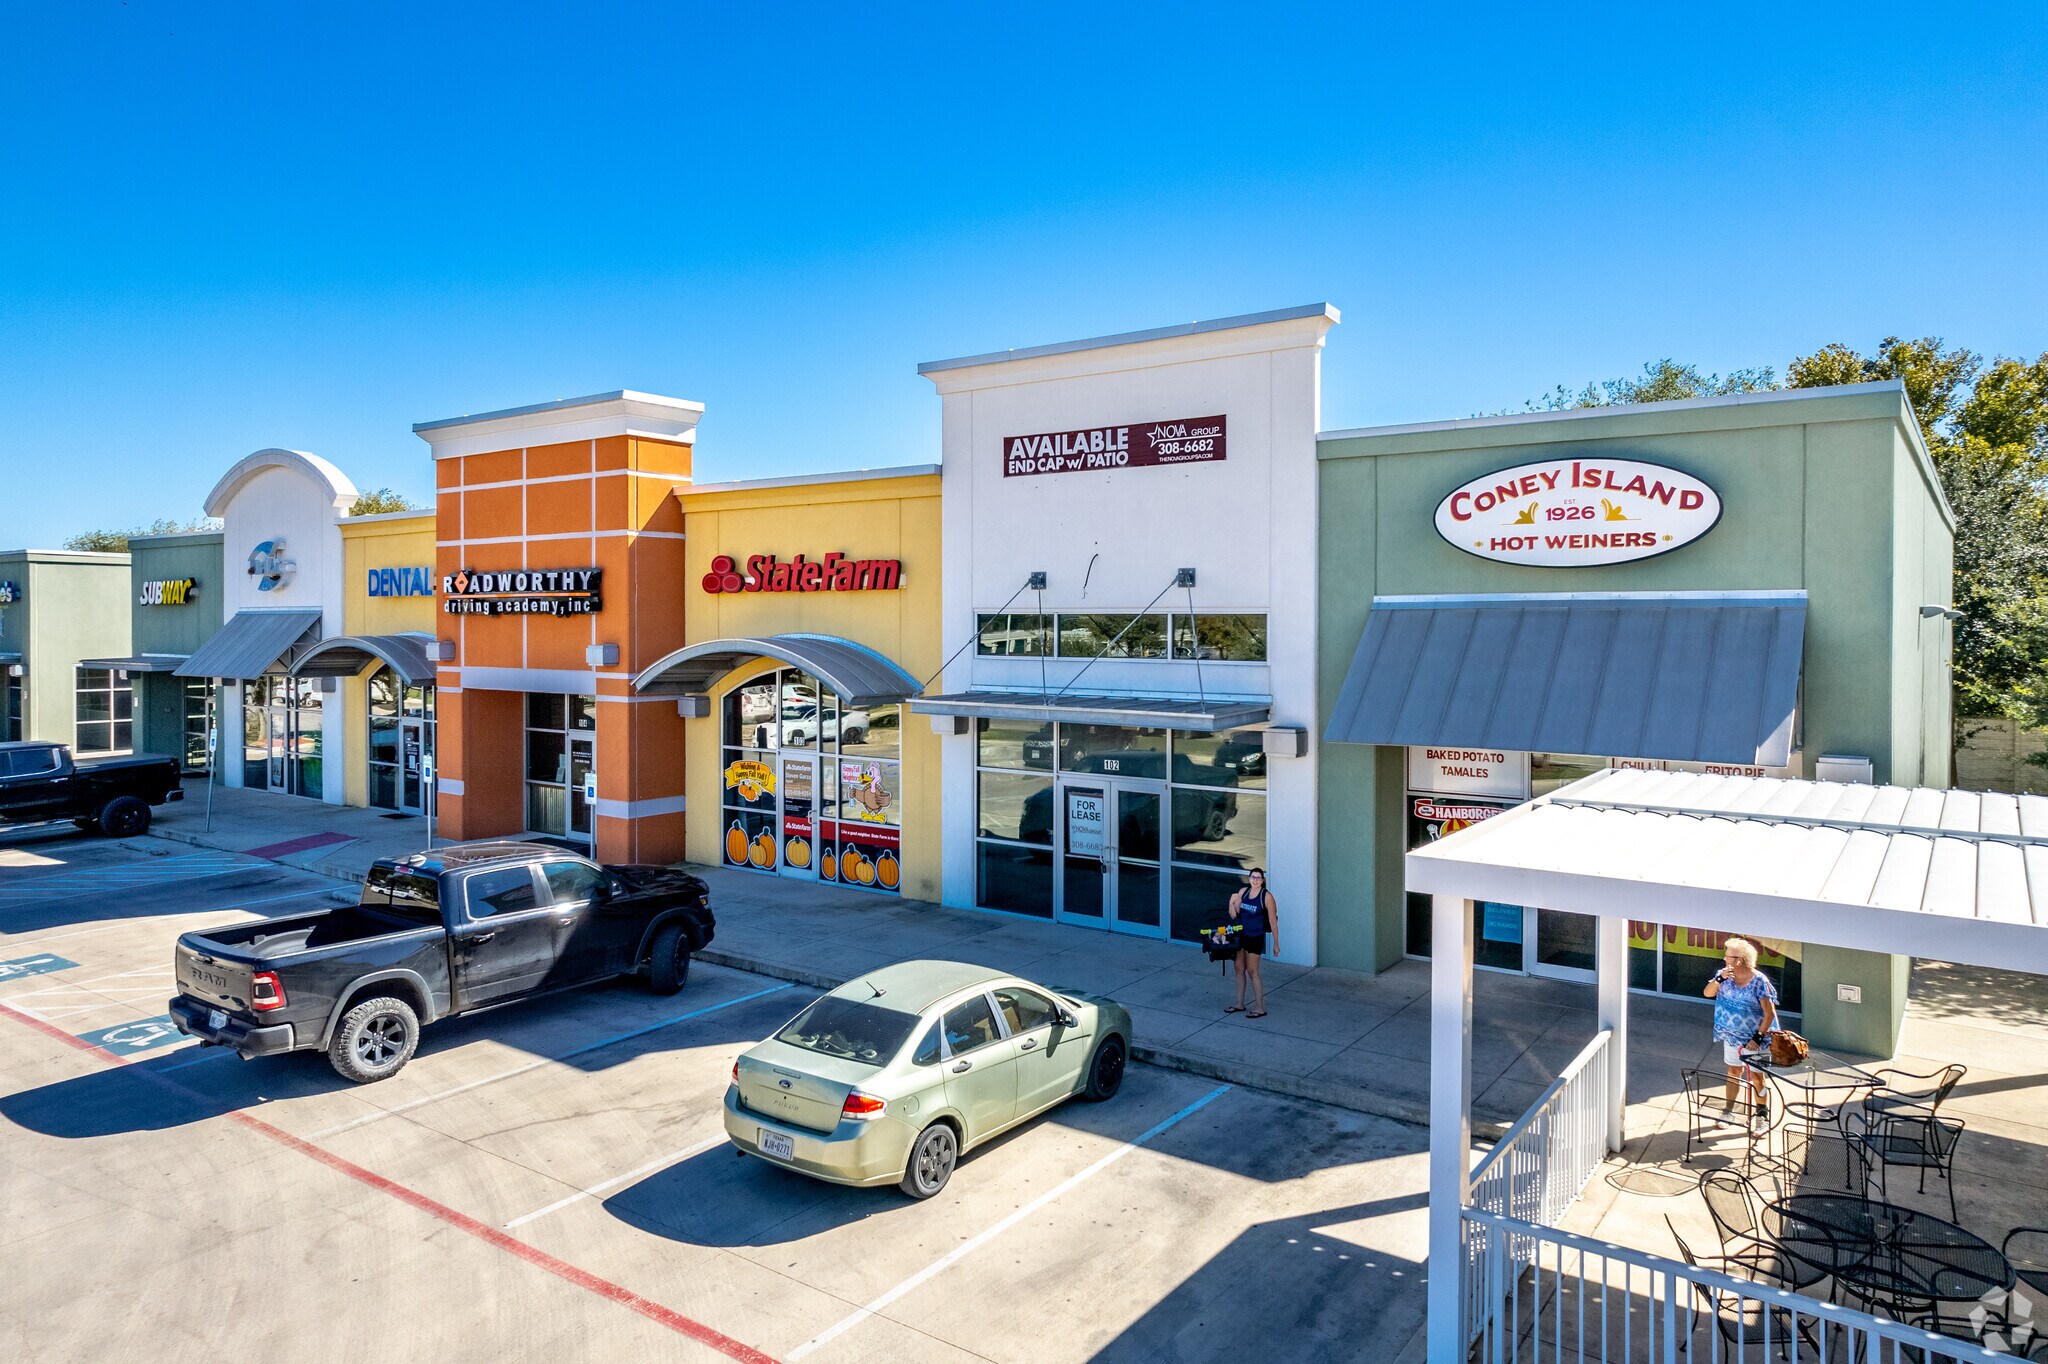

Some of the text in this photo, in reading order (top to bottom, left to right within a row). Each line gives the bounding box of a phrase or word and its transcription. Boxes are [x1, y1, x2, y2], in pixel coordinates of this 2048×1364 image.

[1158, 424, 1220, 439] NOVA GROUP
[1009, 428, 1129, 459] AVAILABLE
[1158, 439, 1214, 455] 308-6682
[1008, 451, 1129, 474] END CAP w/ PATIO
[1545, 505, 1596, 522] 1926
[1490, 532, 1657, 551] HOT WEINERS
[368, 568, 433, 597] DENTAL
[140, 579, 192, 605] SUBWAY
[444, 598, 489, 614] driving
[568, 598, 591, 612] inc
[1426, 749, 1505, 763] BAKED POTATO
[1105, 760, 1119, 770] 102
[1441, 766, 1488, 778] TAMALES
[1077, 800, 1096, 810] FOR
[1072, 810, 1101, 822] LEASE
[190, 967, 227, 988] RAM
